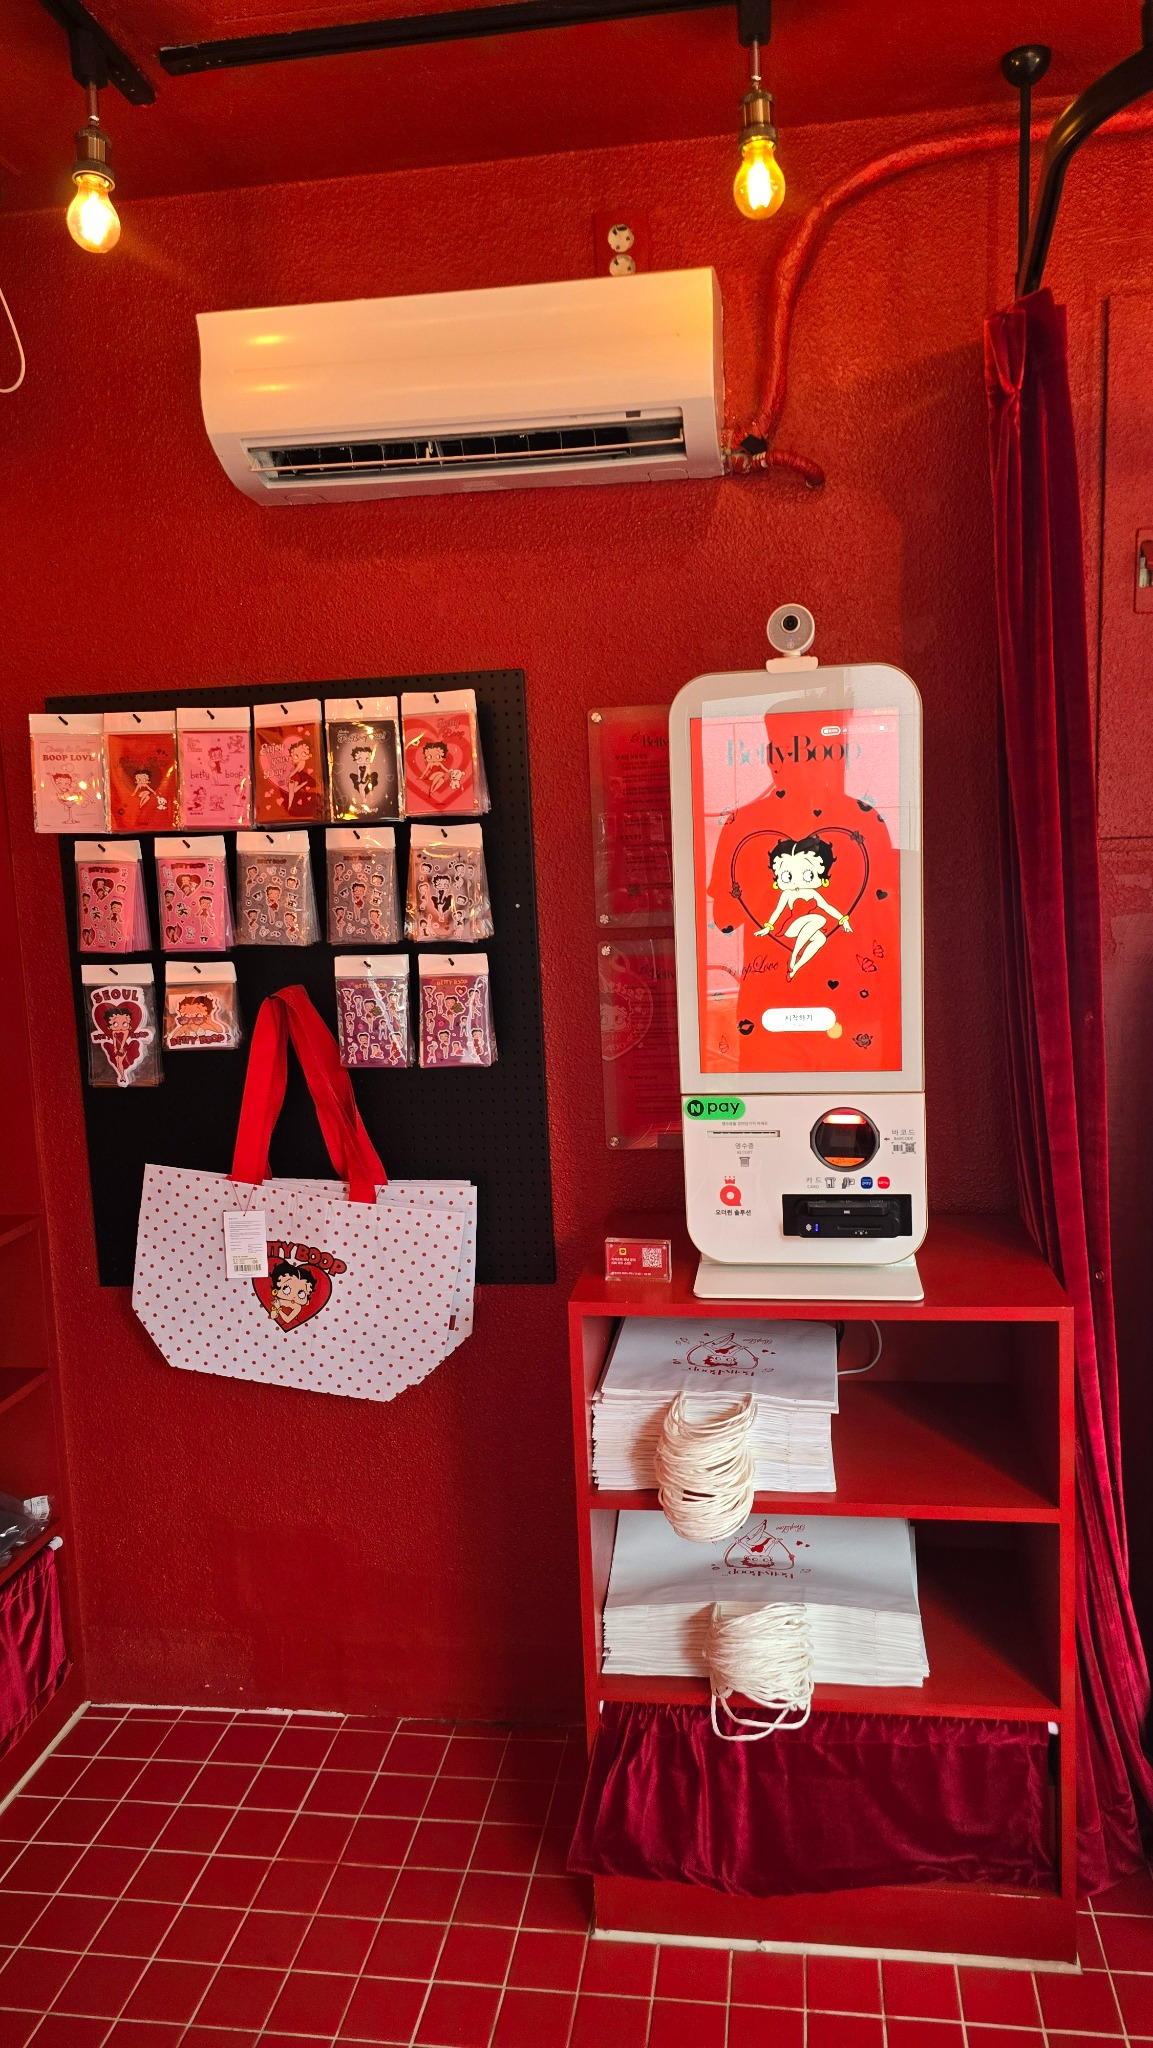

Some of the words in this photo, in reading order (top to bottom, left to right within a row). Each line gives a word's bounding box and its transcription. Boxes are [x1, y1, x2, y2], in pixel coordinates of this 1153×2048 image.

[259, 743, 285, 756] Enjoy
[271, 756, 289, 768] your
[190, 769, 210, 781] betty
[225, 769, 244, 780] boop
[263, 764, 287, 779] Day!
[92, 988, 139, 1004] SEOUL
[784, 1013, 813, 1022] 시작하기
[707, 1102, 740, 1115] pay
[735, 1142, 755, 1150] 영수증
[266, 1241, 296, 1260] TTY
[295, 1243, 348, 1277] BOOP
